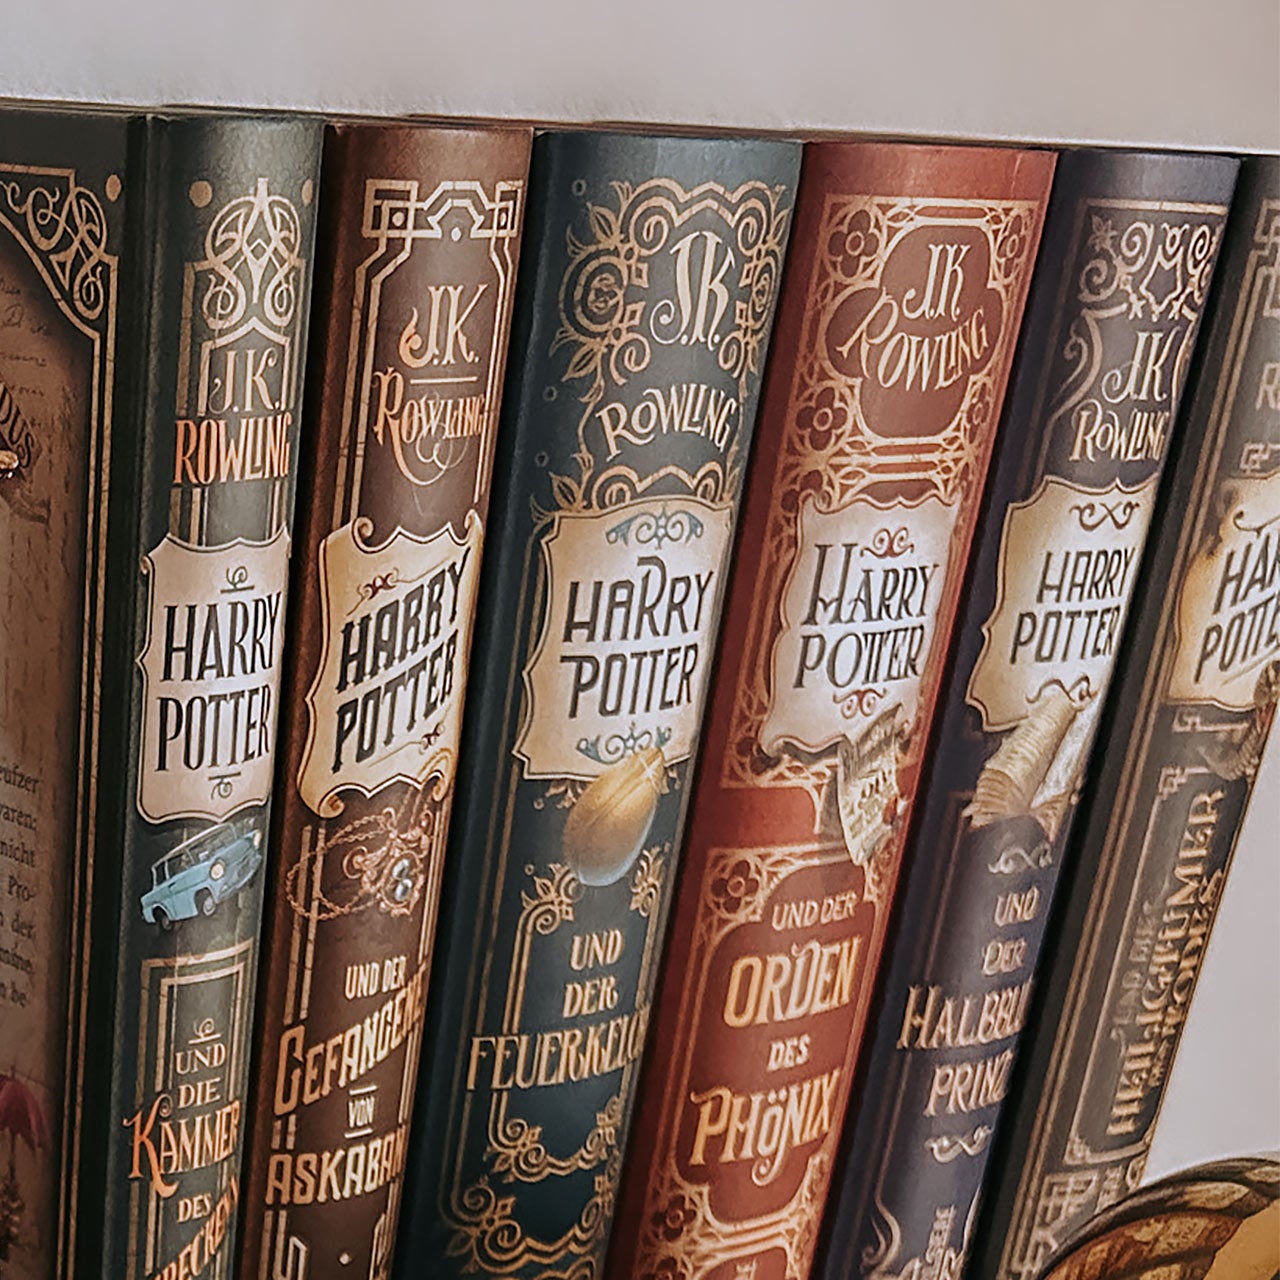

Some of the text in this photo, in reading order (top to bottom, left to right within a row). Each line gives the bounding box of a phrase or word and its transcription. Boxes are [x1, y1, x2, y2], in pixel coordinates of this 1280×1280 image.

[650, 231, 737, 350] J.K.
[902, 244, 971, 320] J.K.
[399, 284, 488, 369] J.K.
[836, 286, 988, 392] ROWLING
[208, 348, 282, 414] J.K.
[1101, 326, 1181, 404] J.K.
[173, 414, 292, 486] ROWLING
[374, 366, 485, 485] ROWLING
[595, 383, 738, 461] ROWLING
[562, 555, 714, 643] HARRY
[801, 543, 940, 626] HARRY
[1036, 547, 1136, 604] HARRY
[159, 591, 283, 683] HARRY
[335, 547, 470, 695] HARRY
[793, 625, 924, 690] POTTER
[1009, 604, 1121, 665] POTTER
[331, 629, 459, 775] POTTER
[560, 643, 699, 720] POTTER
[155, 684, 273, 772] POTTER
[0, 839, 36, 868] nicht
[772, 891, 857, 932] UND DER
[994, 886, 1040, 927] UND
[344, 955, 408, 1000] UND DER
[570, 929, 623, 971] UND
[723, 936, 862, 1029] ORDEN
[981, 938, 1027, 976] DER
[562, 974, 619, 1019] DER
[175, 1042, 226, 1075] UND
[767, 1033, 811, 1072] DES
[177, 1077, 221, 1109] DIE
[348, 1095, 376, 1129] VON
[689, 1066, 842, 1188] PHÖNIX
[122, 1093, 241, 1198] KAMMER
[264, 1123, 407, 1206] ASKABAN
[177, 1193, 212, 1223] DES
